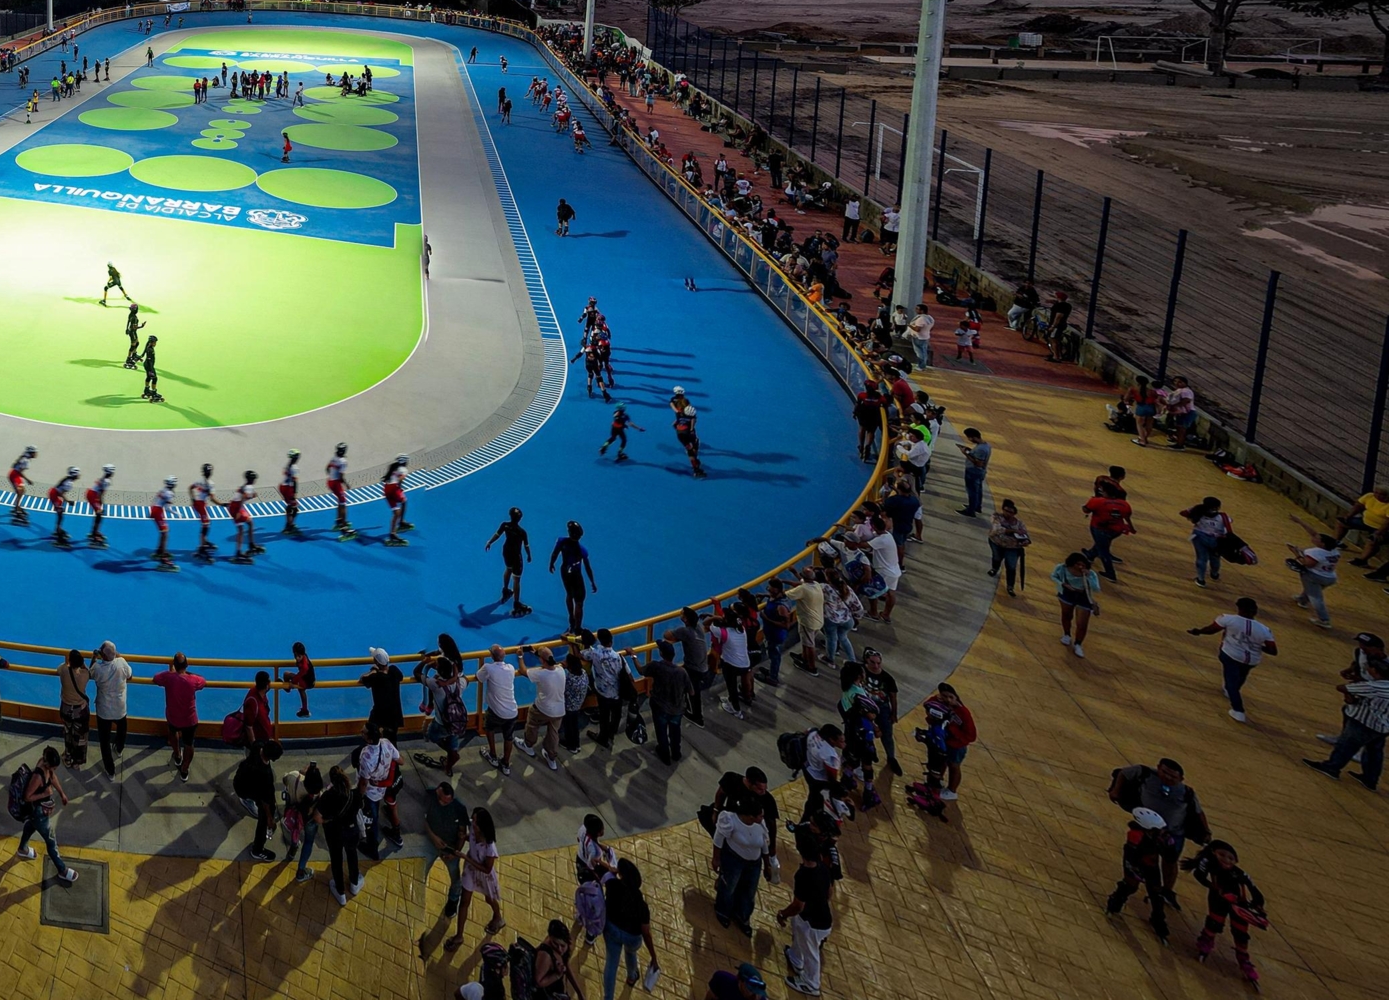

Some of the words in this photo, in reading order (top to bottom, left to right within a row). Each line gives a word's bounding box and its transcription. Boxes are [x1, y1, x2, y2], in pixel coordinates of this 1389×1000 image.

[34, 182, 242, 216] BARRANQUILLA
[115, 200, 139, 210] DE
[145, 203, 237, 221] ALCALDÍA
